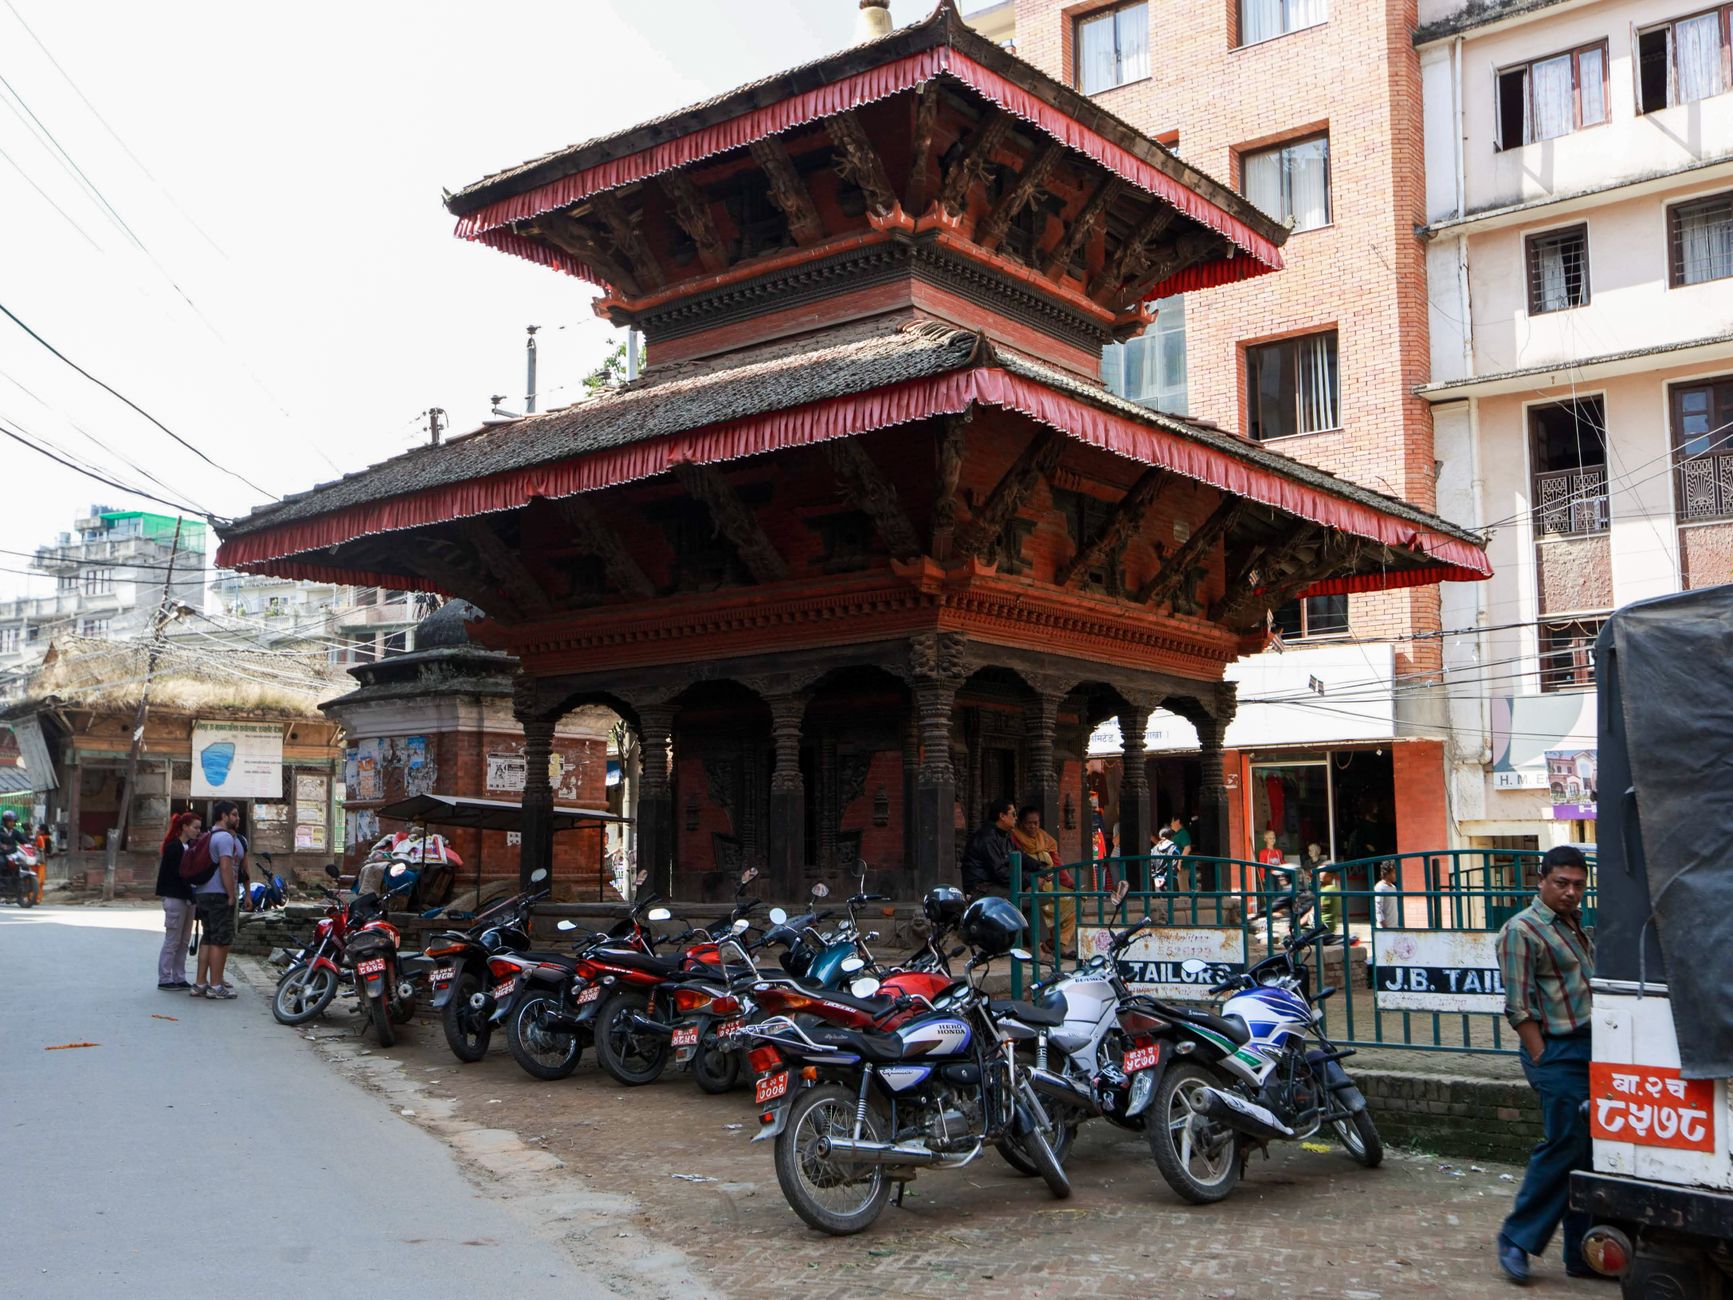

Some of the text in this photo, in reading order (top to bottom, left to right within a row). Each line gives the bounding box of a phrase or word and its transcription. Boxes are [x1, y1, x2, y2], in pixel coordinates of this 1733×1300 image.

[1500, 775, 1513, 786] H.
[1385, 967, 1505, 994] J.B. TAIL
